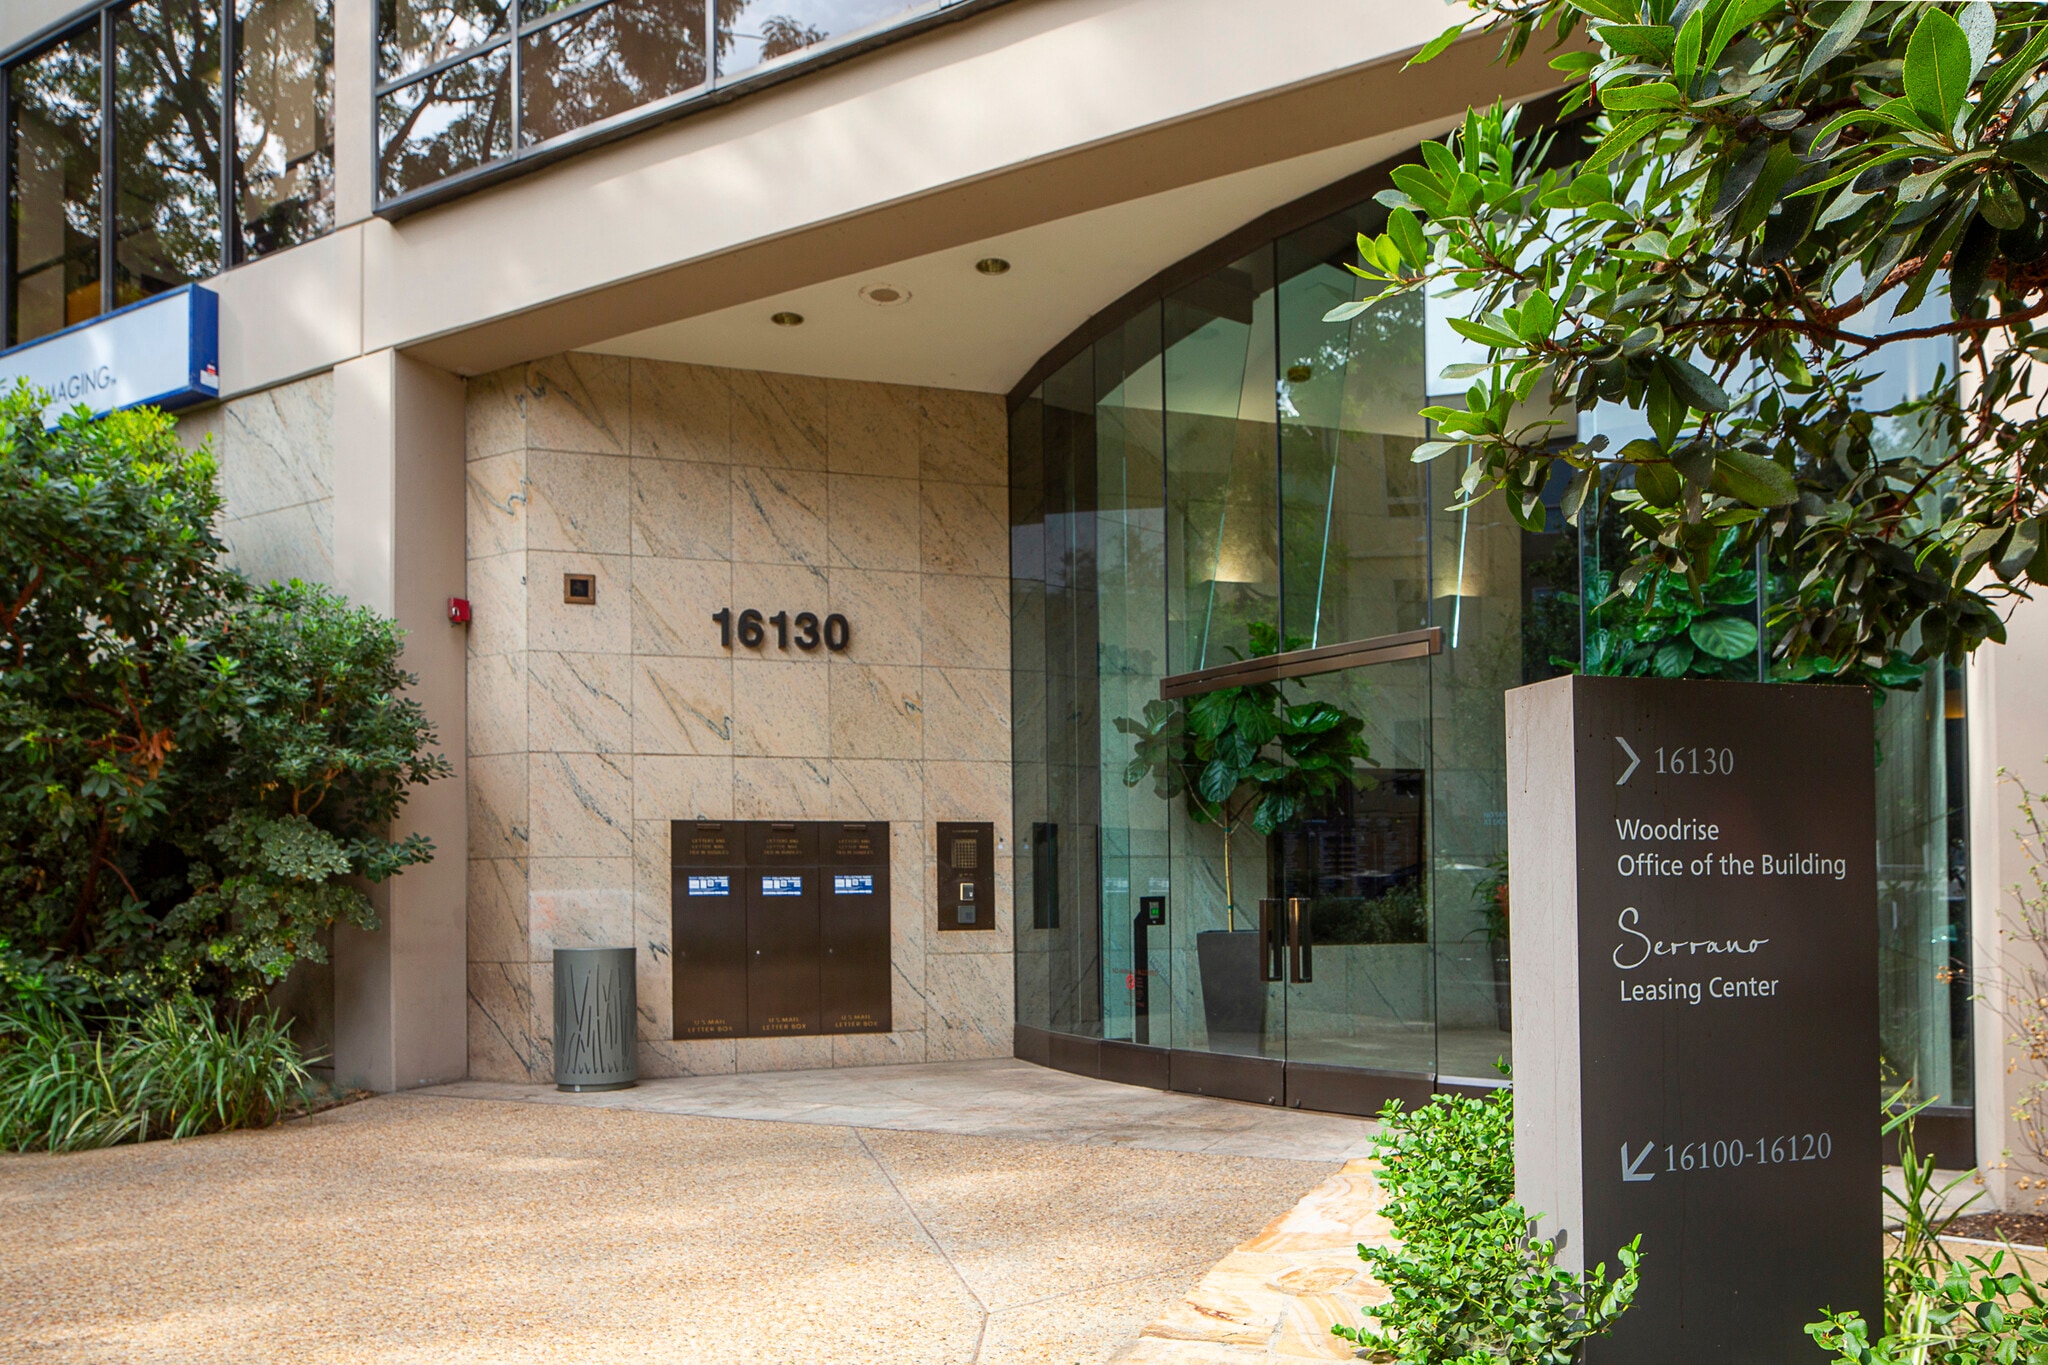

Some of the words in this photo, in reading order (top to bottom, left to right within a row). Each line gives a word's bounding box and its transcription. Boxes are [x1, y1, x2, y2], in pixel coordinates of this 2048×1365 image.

[40, 365, 110, 405] MAGING
[712, 607, 850, 652] 16130
[1654, 746, 1734, 776] 16130
[1615, 817, 1720, 841] Woodrise
[1617, 852, 1684, 877] Office
[1690, 852, 1714, 876] of
[1719, 852, 1755, 876] the
[1761, 852, 1847, 881] Building
[1612, 906, 1770, 970] Serrano
[1620, 977, 1702, 1005] Leasing
[1708, 976, 1779, 998] Center
[1663, 1131, 1832, 1173] 16100-16120
